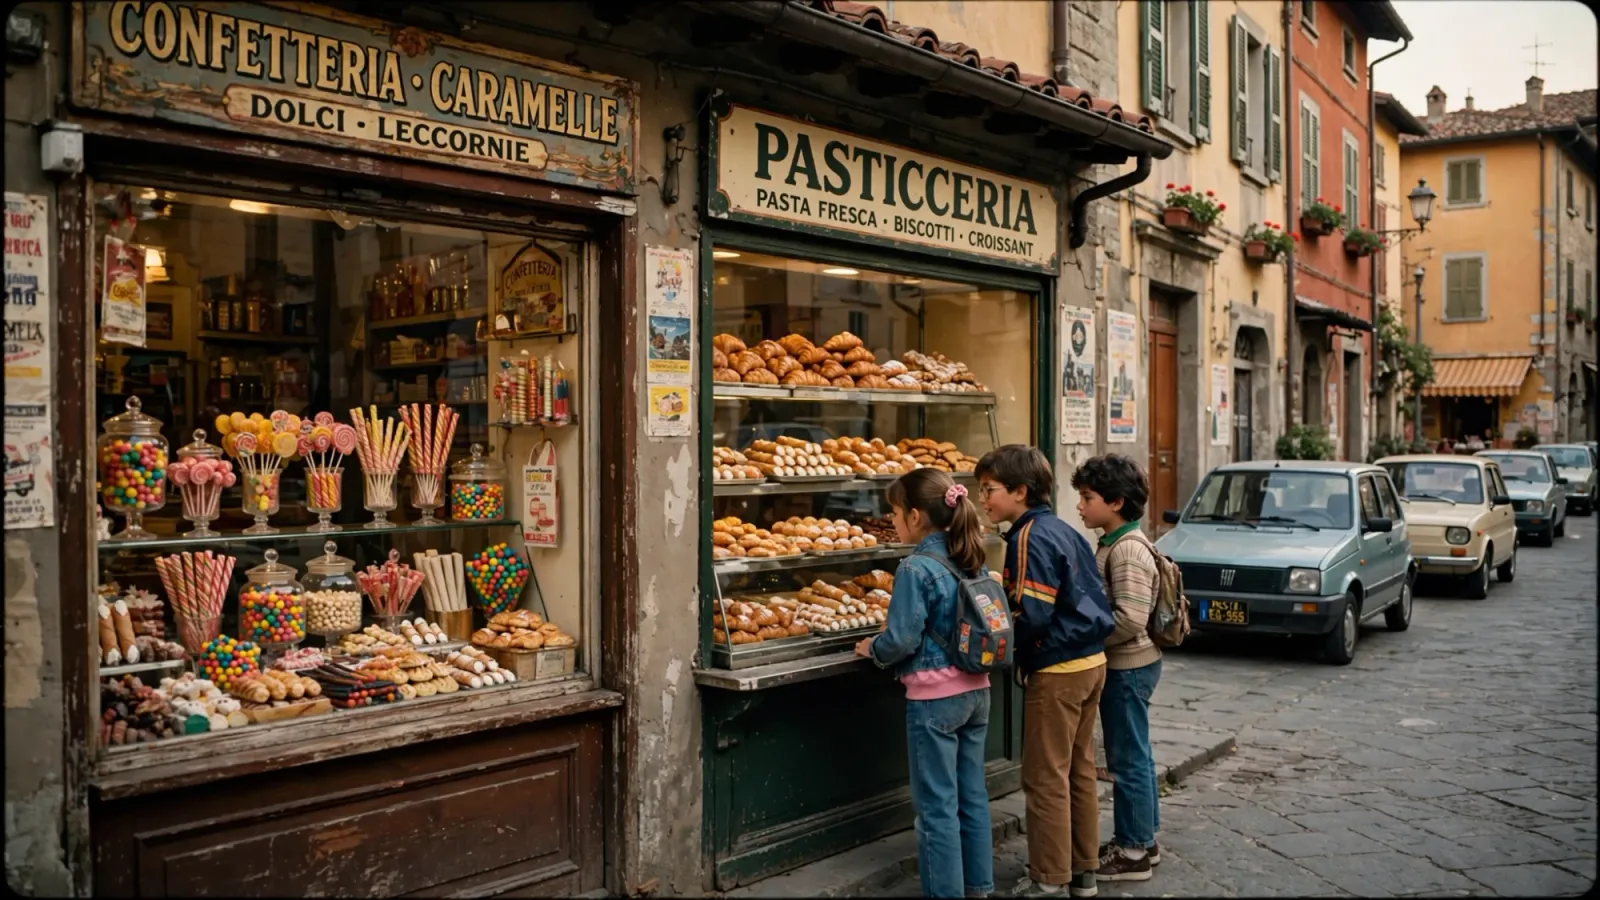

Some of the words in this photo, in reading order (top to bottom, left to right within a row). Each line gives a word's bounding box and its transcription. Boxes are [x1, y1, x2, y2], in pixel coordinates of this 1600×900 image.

[109, 1, 405, 104] CONFETTERIA
[431, 61, 619, 146] CARAMELLE
[251, 94, 345, 132] DOLCI
[378, 116, 529, 163] LECCORNIE
[754, 122, 1038, 236] PASTICCERIA
[756, 189, 812, 216] PASTA
[818, 201, 877, 229] FRESCA
[894, 215, 955, 243] BISCOTTI
[968, 230, 1034, 257] CROISSANT
